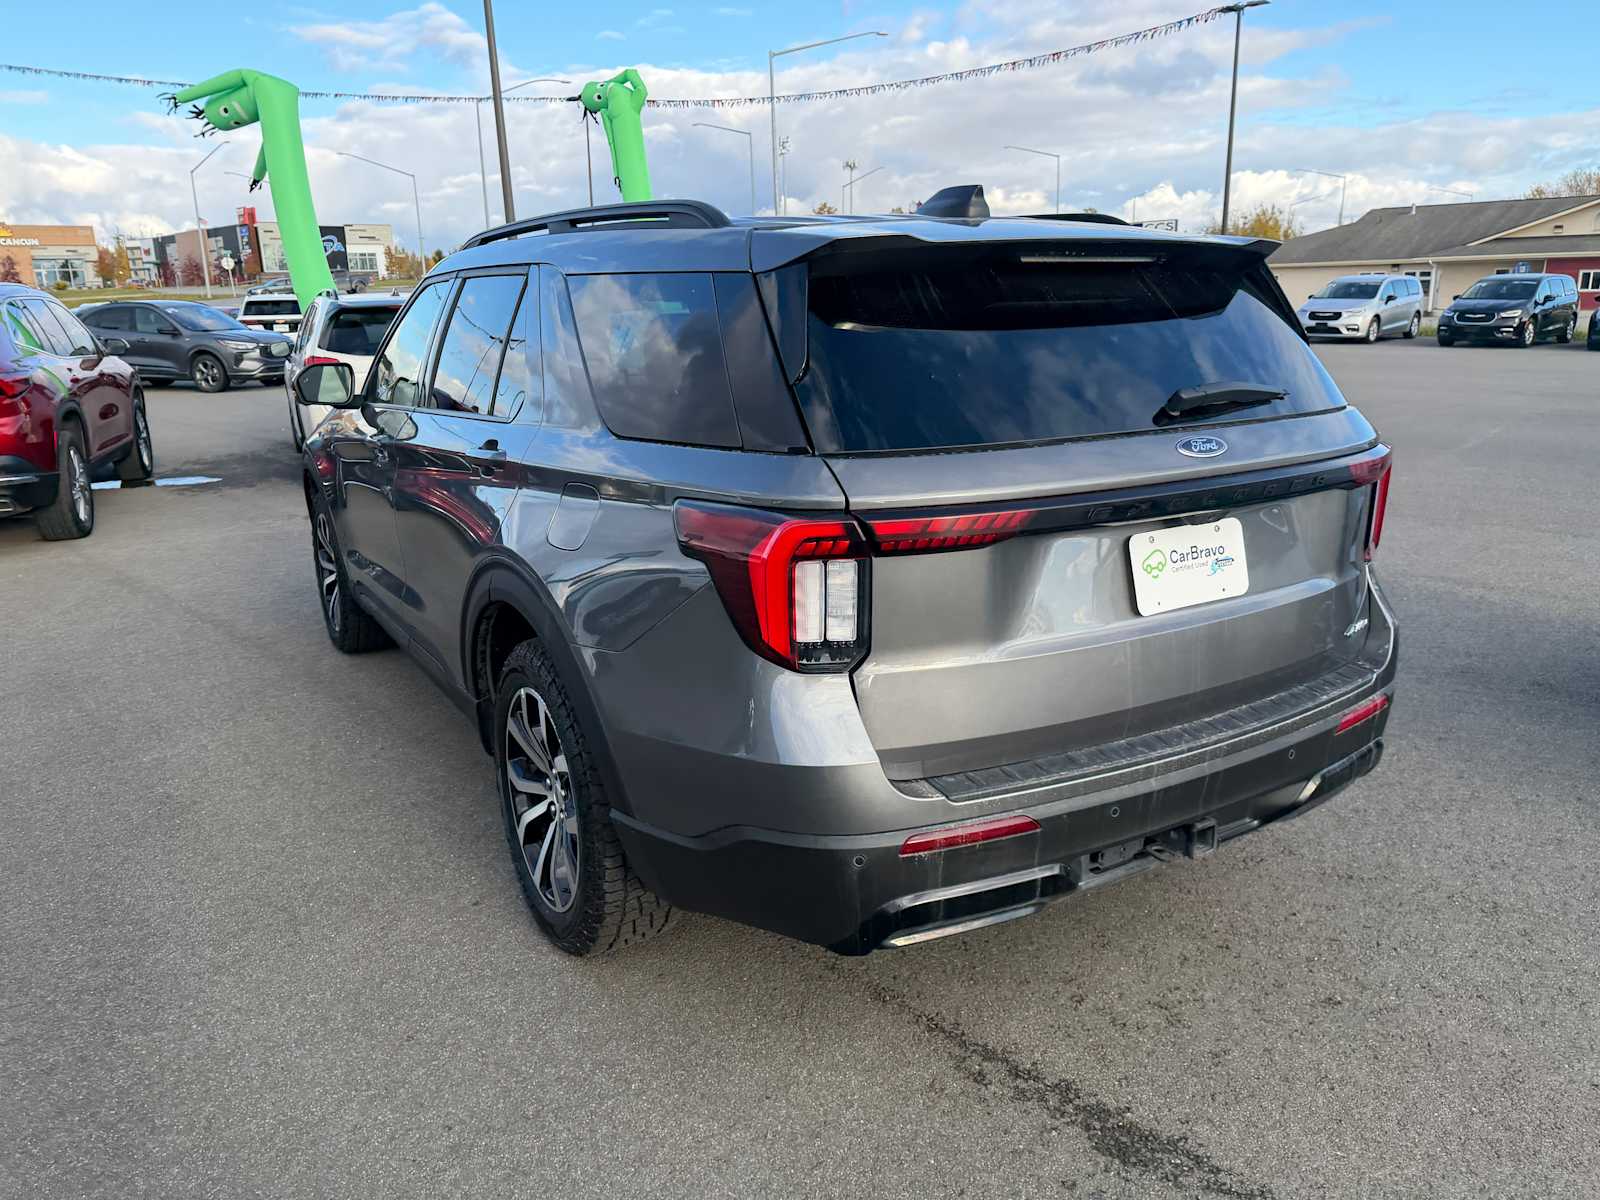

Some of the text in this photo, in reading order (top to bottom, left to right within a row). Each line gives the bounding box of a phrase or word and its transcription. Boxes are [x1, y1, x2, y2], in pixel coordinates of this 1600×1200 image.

[0, 237, 40, 247] CANCUN
[1190, 437, 1219, 452] Ford
[1169, 545, 1225, 564] CarBravo
[1171, 562, 1194, 573] Certified
[1195, 560, 1208, 569] Used
